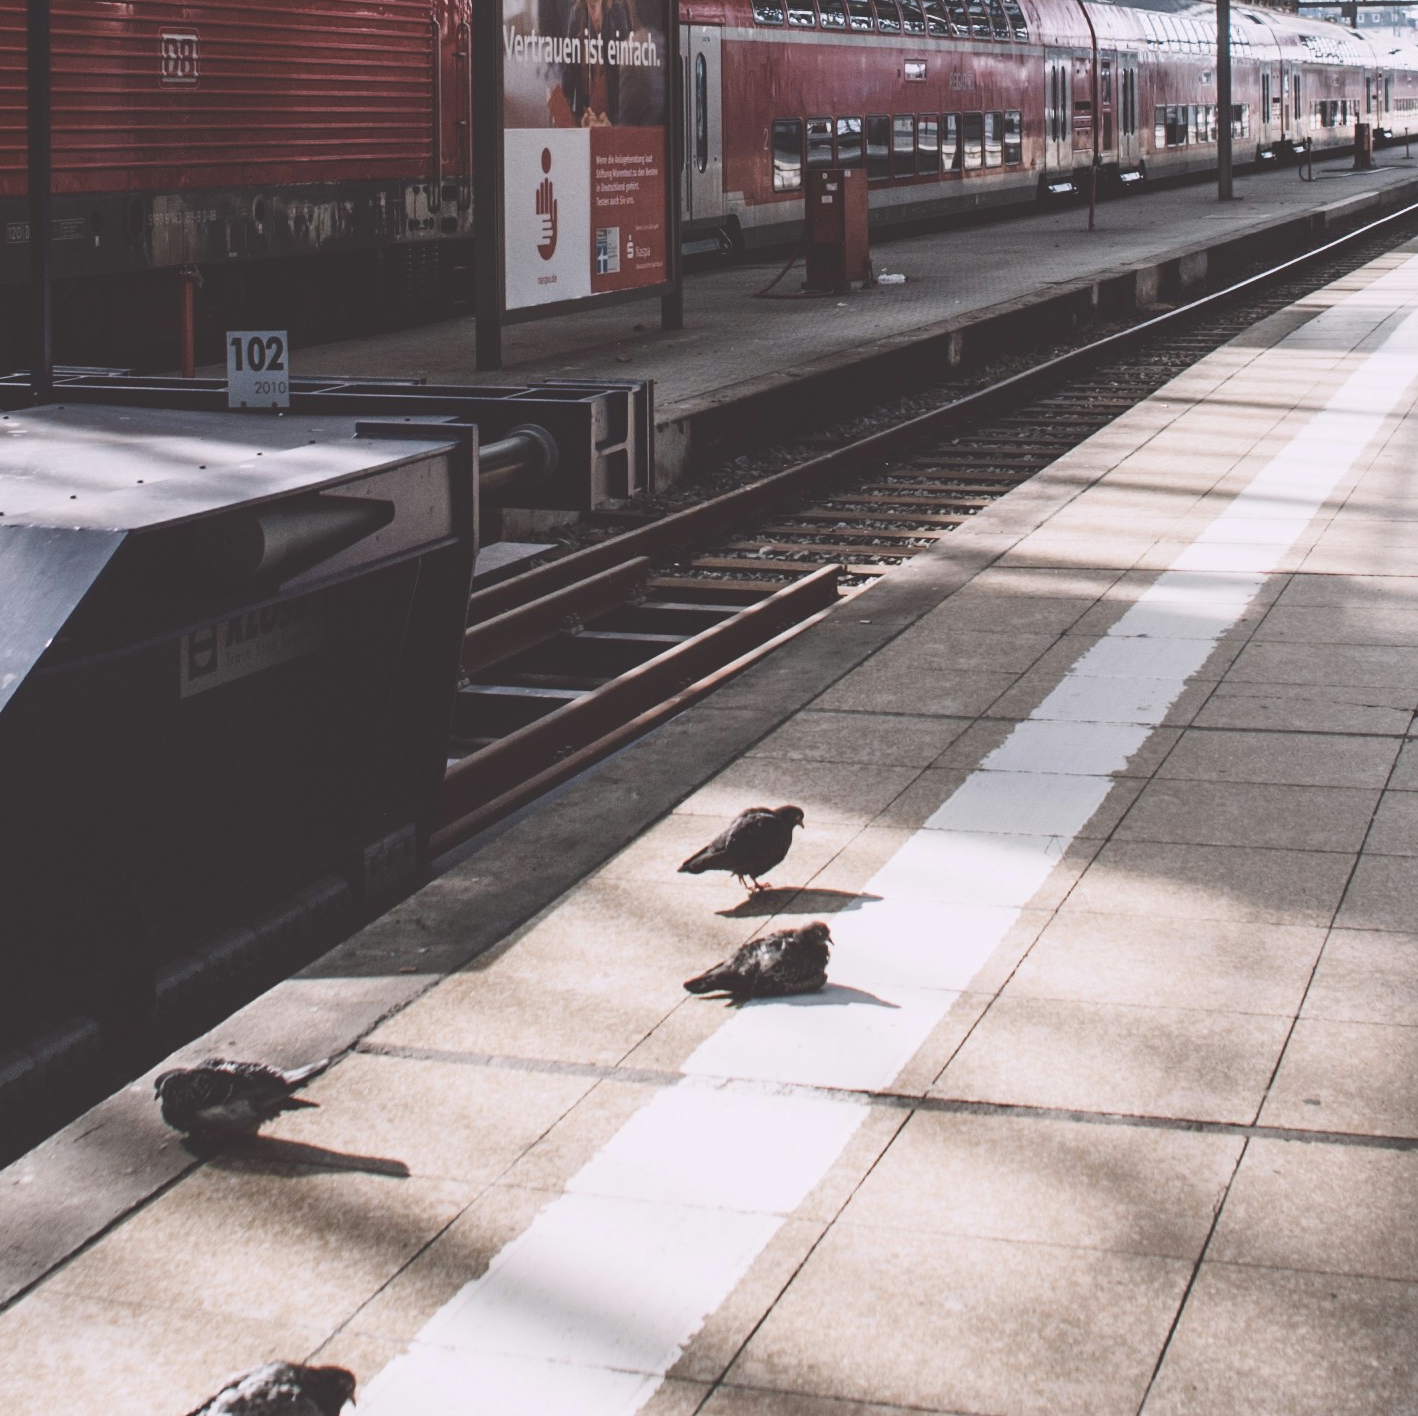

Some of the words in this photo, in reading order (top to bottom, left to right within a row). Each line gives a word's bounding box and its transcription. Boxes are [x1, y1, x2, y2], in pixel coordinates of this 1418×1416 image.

[162, 35, 199, 81] DB
[502, 24, 581, 64] Vertrauen
[584, 28, 604, 65] ist
[607, 30, 661, 67] einfach.
[230, 336, 284, 372] 102
[254, 381, 286, 394] 2010
